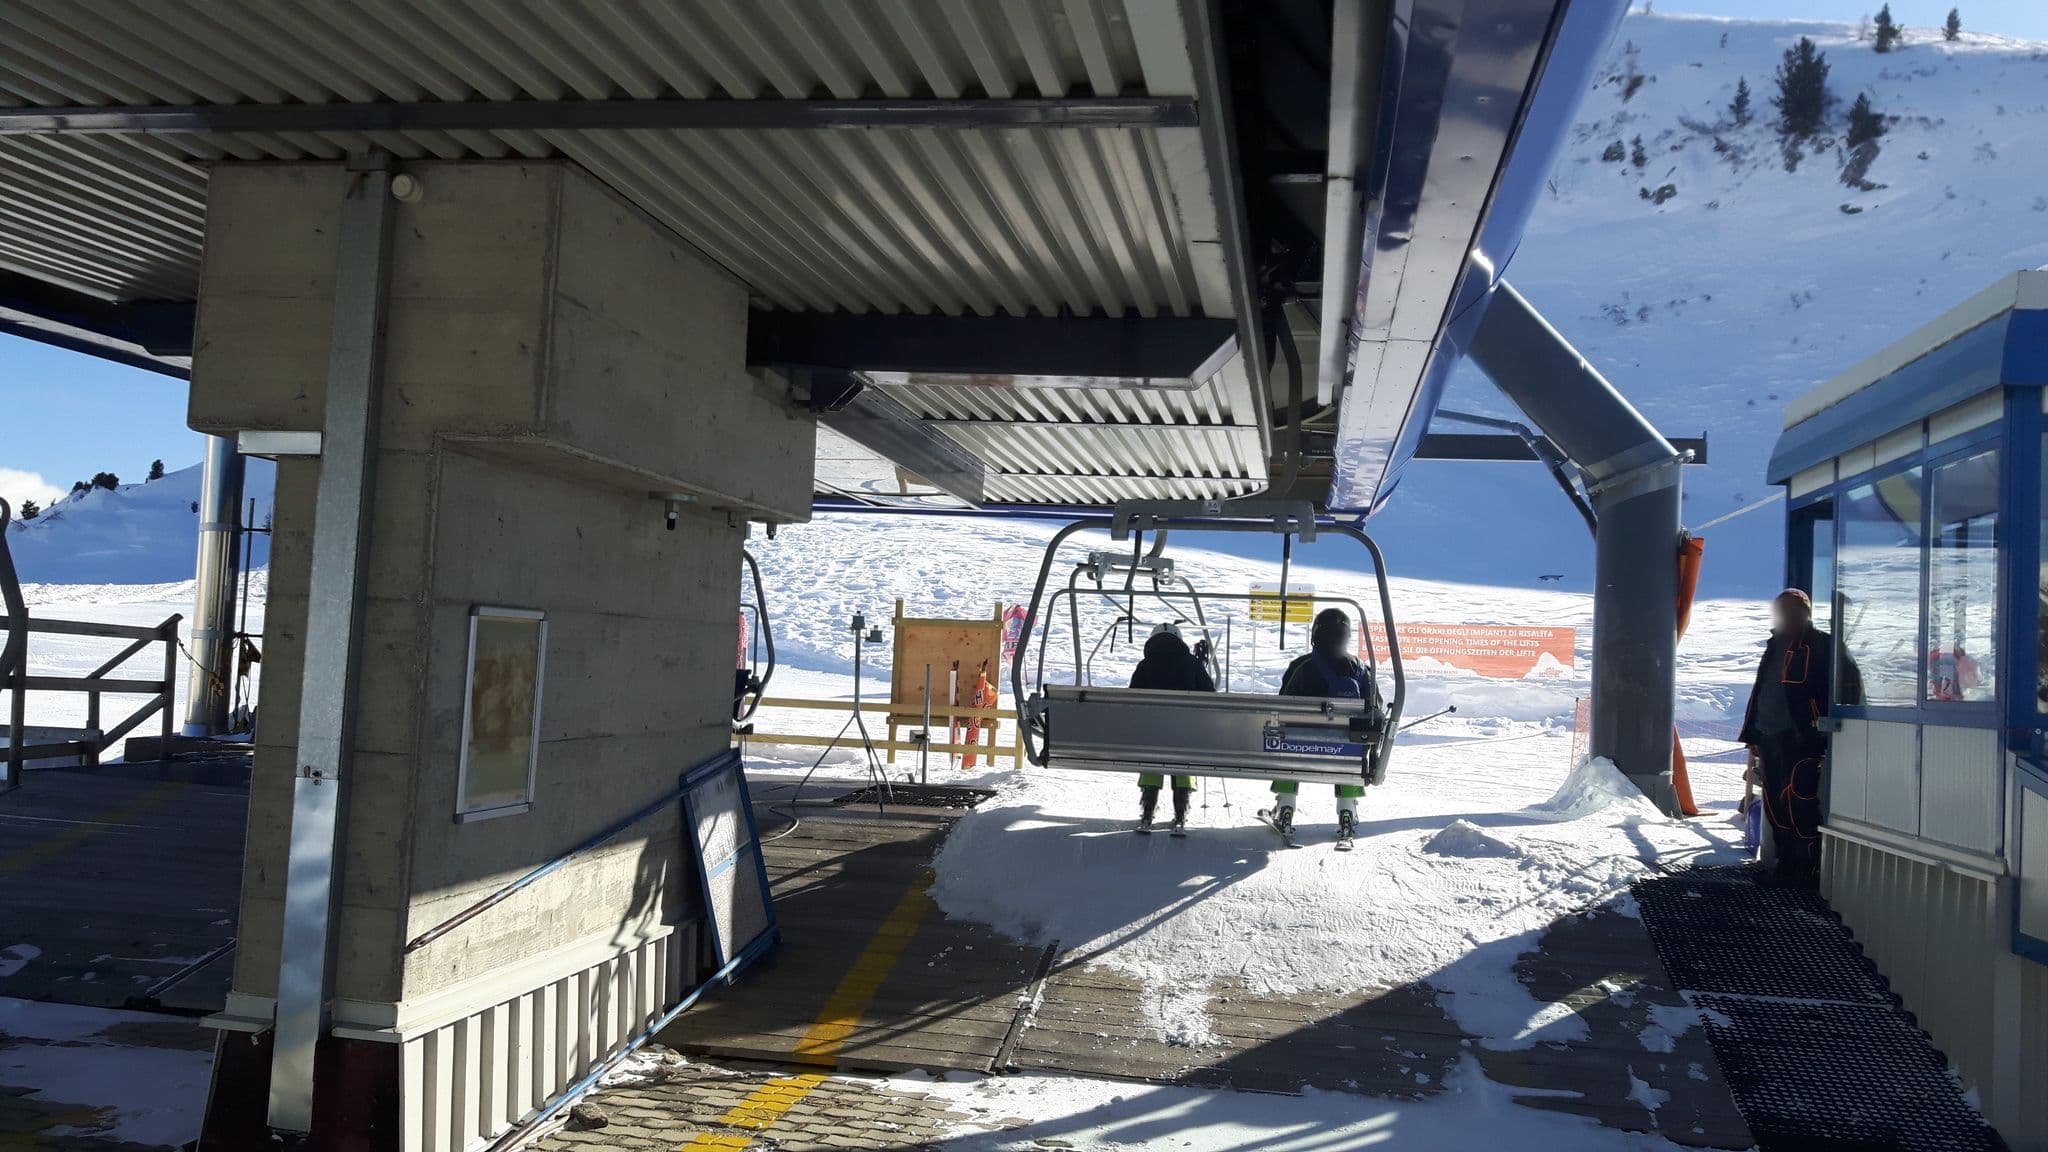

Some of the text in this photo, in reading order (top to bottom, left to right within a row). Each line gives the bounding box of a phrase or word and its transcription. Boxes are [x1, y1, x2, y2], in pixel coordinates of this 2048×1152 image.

[1362, 625, 1405, 634] SPETRE
[1446, 628, 1468, 636] DEGLI
[1413, 636, 1427, 644] THE
[1429, 637, 1464, 645] OPENING
[1362, 644, 1401, 652] BCHT
[1281, 742, 1341, 754] Doppelmayr
